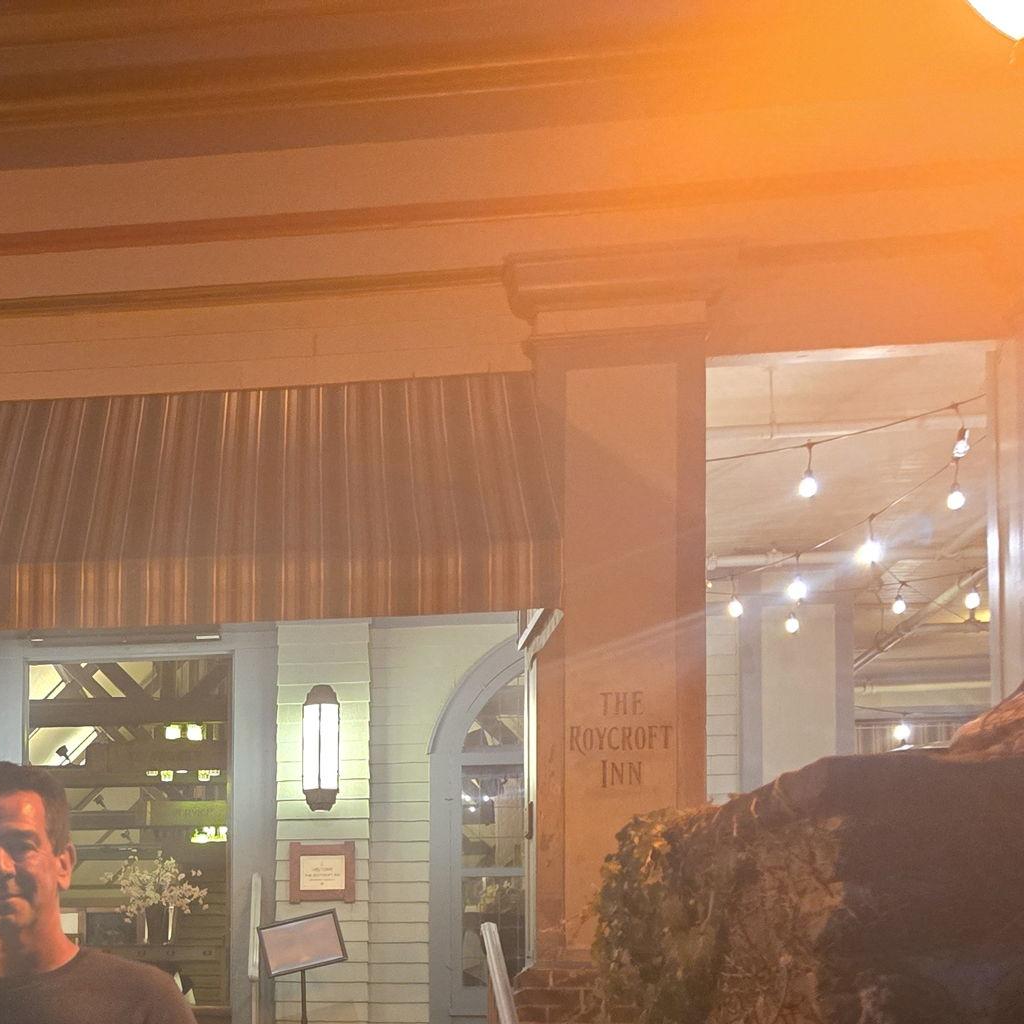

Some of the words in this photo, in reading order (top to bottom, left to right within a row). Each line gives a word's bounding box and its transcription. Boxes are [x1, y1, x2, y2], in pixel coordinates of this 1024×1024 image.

[599, 690, 644, 716] THE
[569, 725, 673, 757] ROYCROFT
[600, 759, 643, 788] INN
